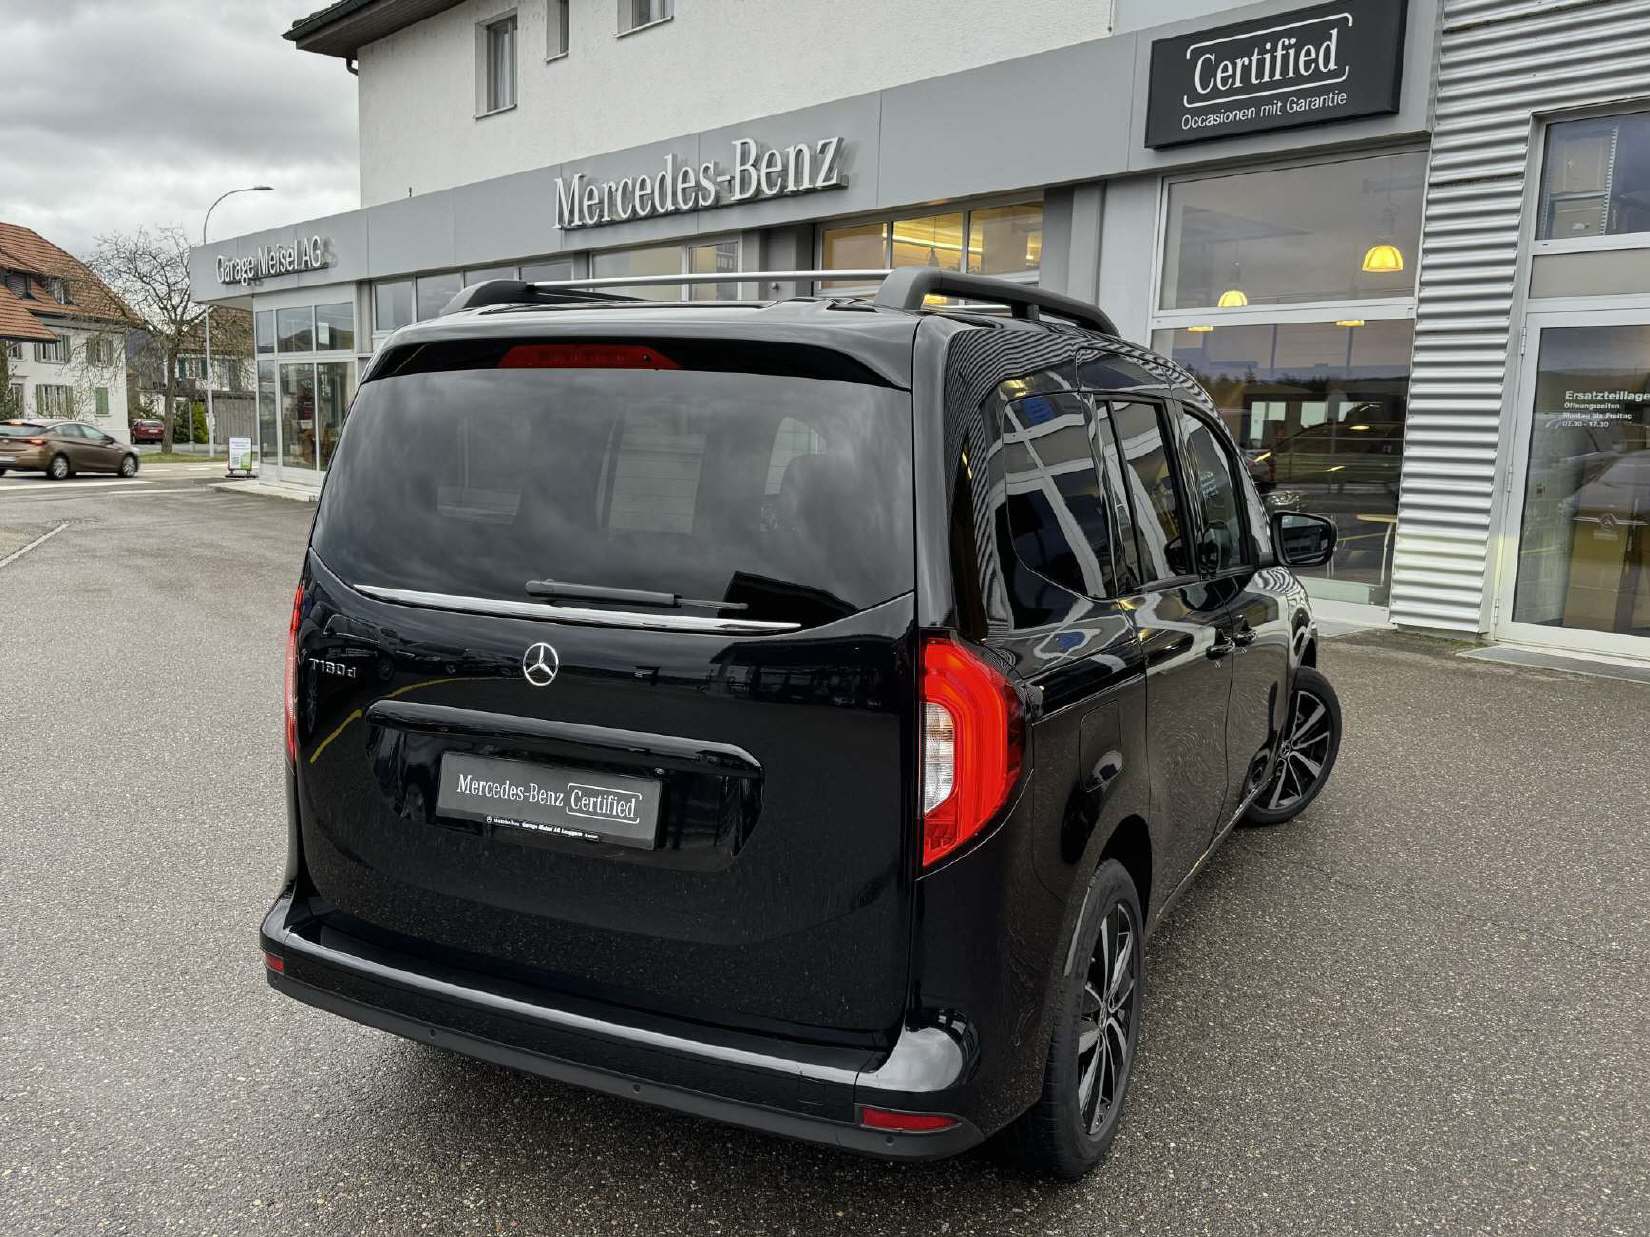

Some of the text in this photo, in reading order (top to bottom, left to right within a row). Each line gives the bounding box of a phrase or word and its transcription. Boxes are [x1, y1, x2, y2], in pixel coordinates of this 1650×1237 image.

[1194, 27, 1338, 94] Certified
[1181, 91, 1347, 130] Occasionen mit Garantie
[552, 136, 841, 230] Mercedes-Benz
[215, 235, 321, 286] Garage Meisel AG
[456, 774, 635, 818] Mercedes-Benz Certified
